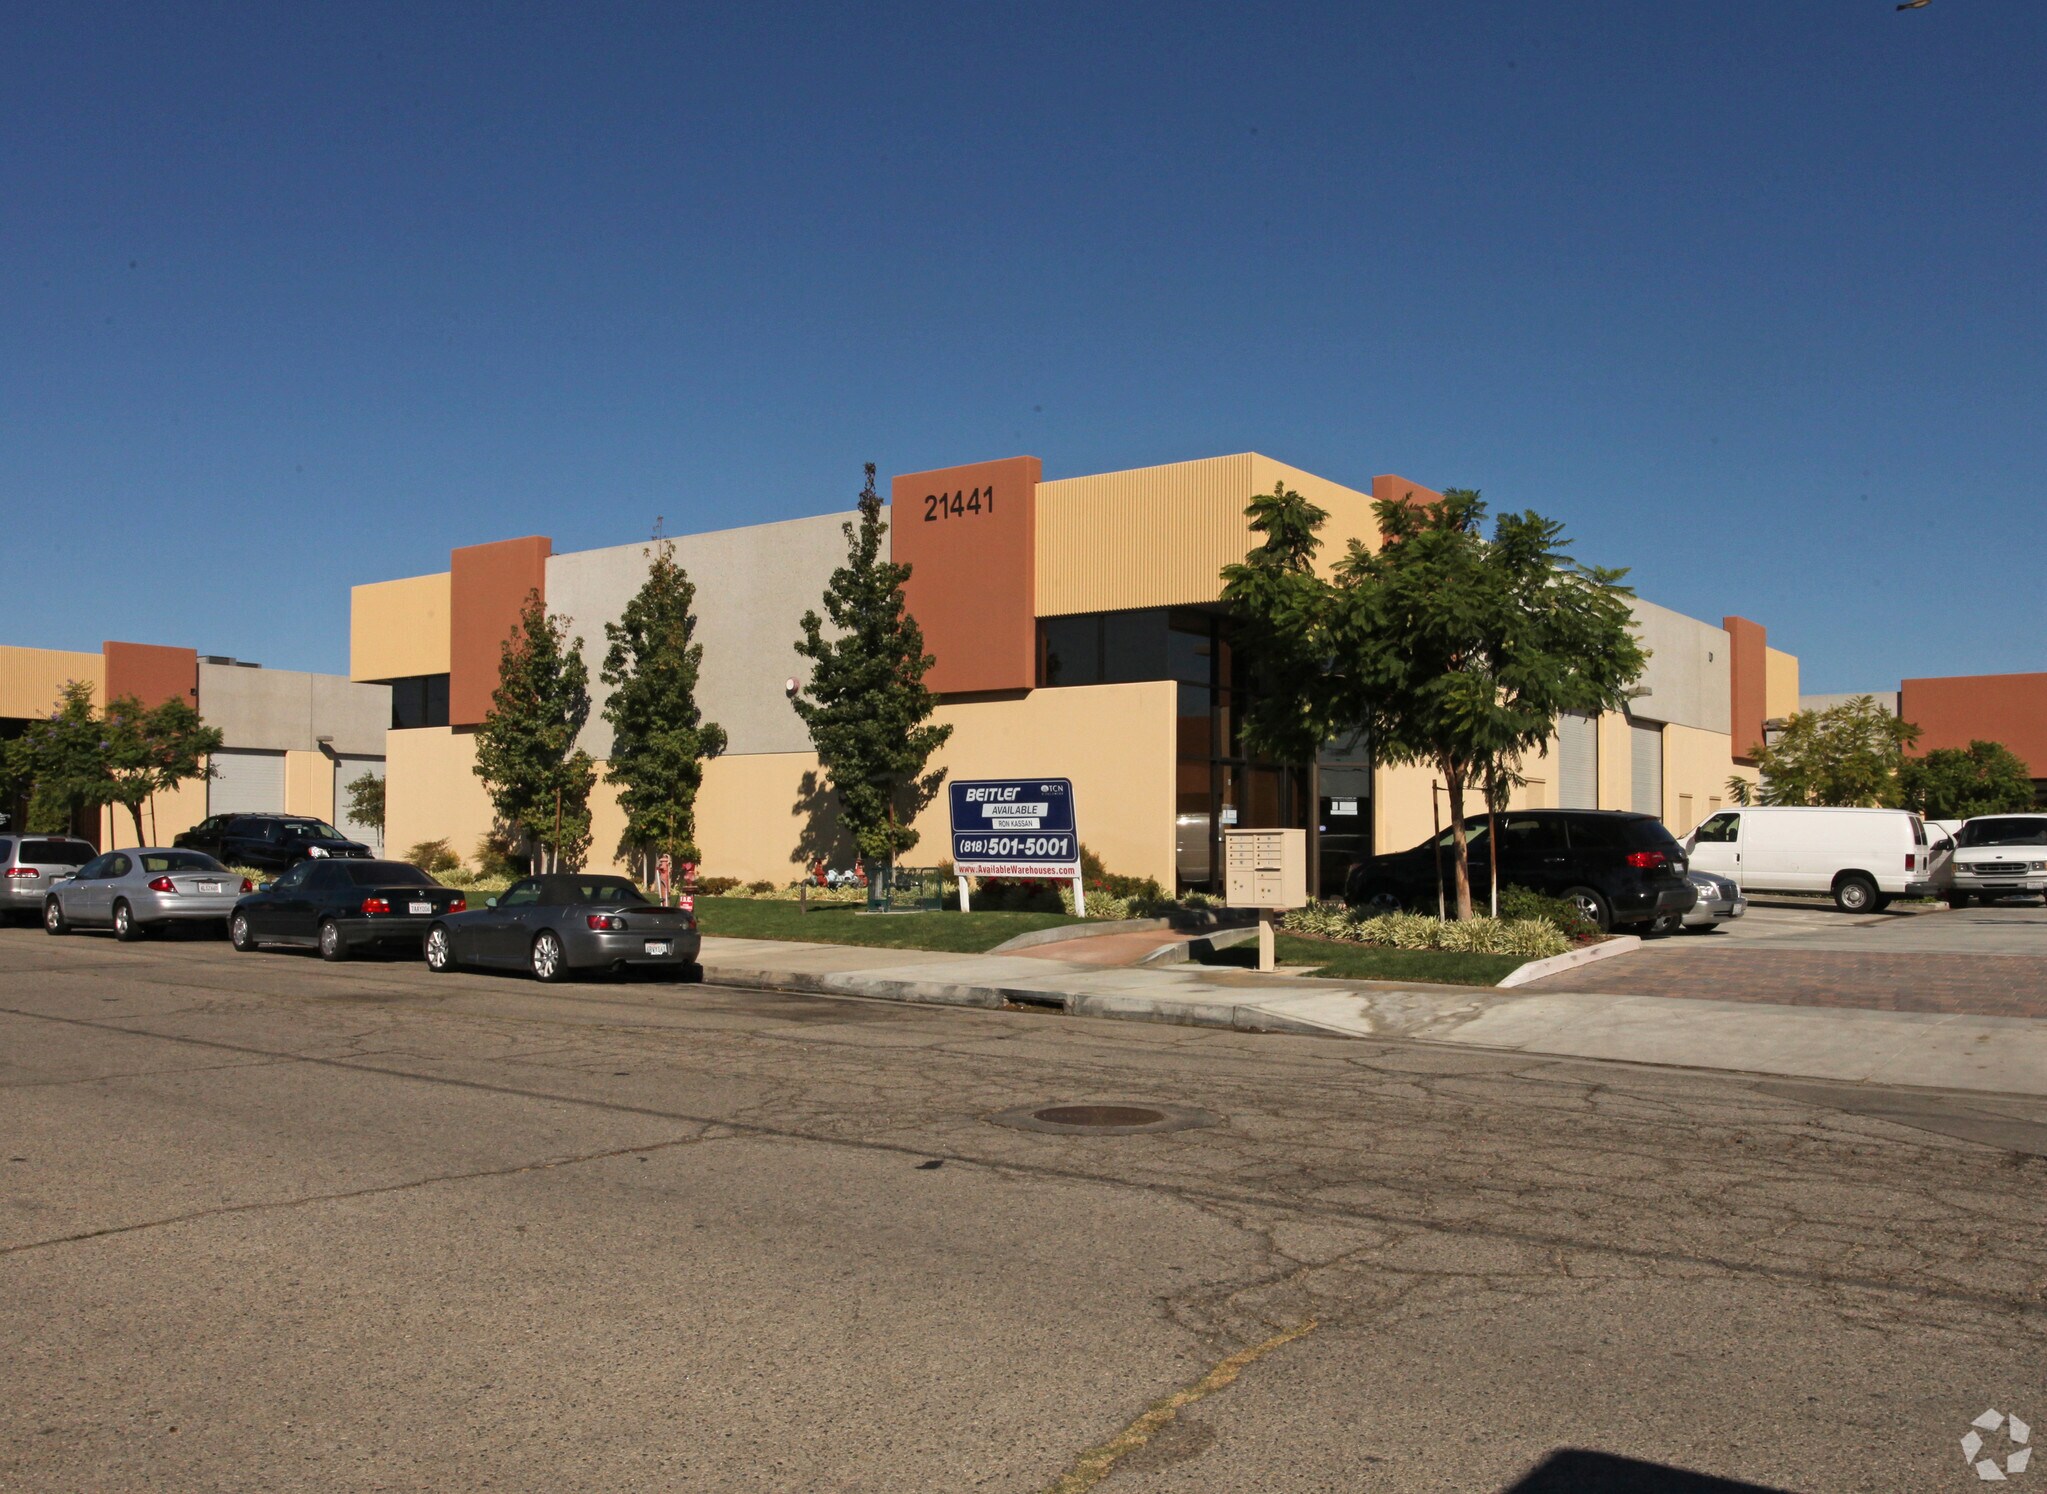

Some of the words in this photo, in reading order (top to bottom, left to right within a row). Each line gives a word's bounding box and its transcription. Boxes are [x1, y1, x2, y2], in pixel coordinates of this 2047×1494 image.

[924, 486, 993, 521] 21441
[1049, 784, 1064, 792] TCN
[992, 805, 1038, 815] AVAILABLE
[998, 820, 1010, 828] RON
[1011, 820, 1033, 828] KASSAN
[960, 839, 987, 854] (818)
[988, 837, 1068, 856] 501-5001
[959, 865, 1075, 875] www.AvailableWarehouses.com
